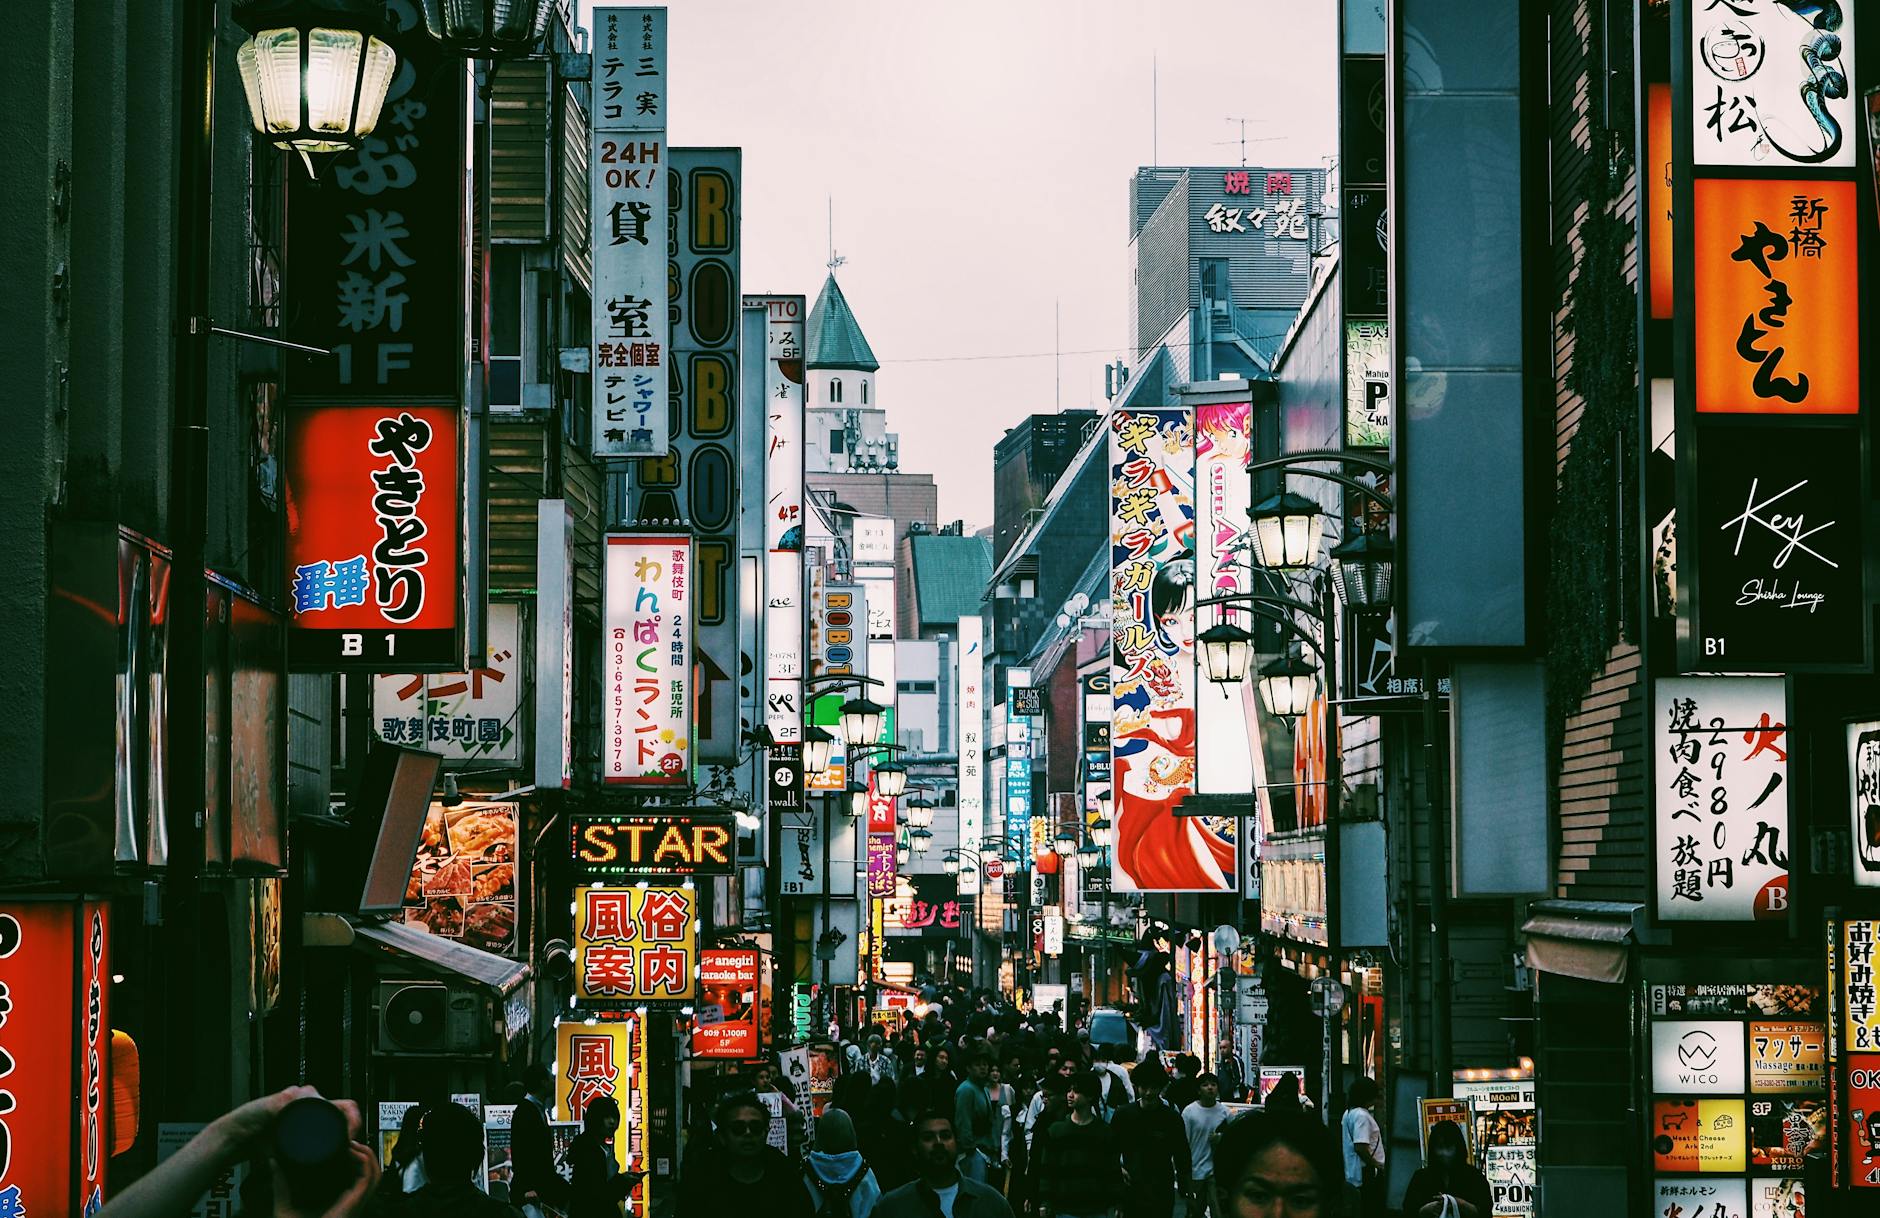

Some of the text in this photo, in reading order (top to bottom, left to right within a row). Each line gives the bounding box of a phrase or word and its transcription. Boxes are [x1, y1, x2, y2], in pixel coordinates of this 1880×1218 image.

[601, 14, 624, 119] 株式会社 テラコ
[635, 14, 659, 116] 株式会社 三実
[601, 142, 658, 163] 24H
[605, 169, 656, 188] OK!
[1224, 172, 1293, 194] 焼肉
[1204, 198, 1309, 239] 叙々苑
[1789, 196, 1828, 259] 新橋
[607, 202, 652, 337] 貸室
[1731, 221, 1809, 403] やきとん
[598, 343, 660, 367] 完全個室
[783, 348, 799, 358] 5F
[688, 166, 735, 626] ROBOT
[370, 414, 431, 622] やきとり
[1721, 478, 1838, 569] Key
[1118, 416, 1158, 682] ギラギラガールズ
[1736, 579, 1786, 605] Shisha
[671, 550, 684, 718] 歌舞伎町 24時間 託児所
[1705, 638, 1725, 655] B1
[634, 556, 661, 765] わんぱくランド
[1386, 678, 1452, 694] 相席場
[382, 717, 501, 743] 歌舞伎町園
[781, 728, 798, 738] 2F
[664, 759, 680, 770] 2F
[778, 772, 791, 782] 2F
[1669, 697, 1704, 901] 焼肉食べ放題
[1707, 718, 1734, 888] 2980円
[1741, 713, 1788, 870] 火ノ丸
[580, 826, 729, 863] STAR
[1766, 886, 1788, 911] B
[582, 891, 689, 941] 風俗
[586, 945, 686, 995] 案内
[715, 955, 754, 969] anegirl
[738, 970, 754, 980] bar
[1848, 922, 1874, 1025] お好み焼き
[1755, 1036, 1825, 1058] マッサー
[1679, 1075, 1718, 1084] WICO
[1755, 1060, 1793, 1073] Massage
[1753, 1103, 1771, 1115] 3F
